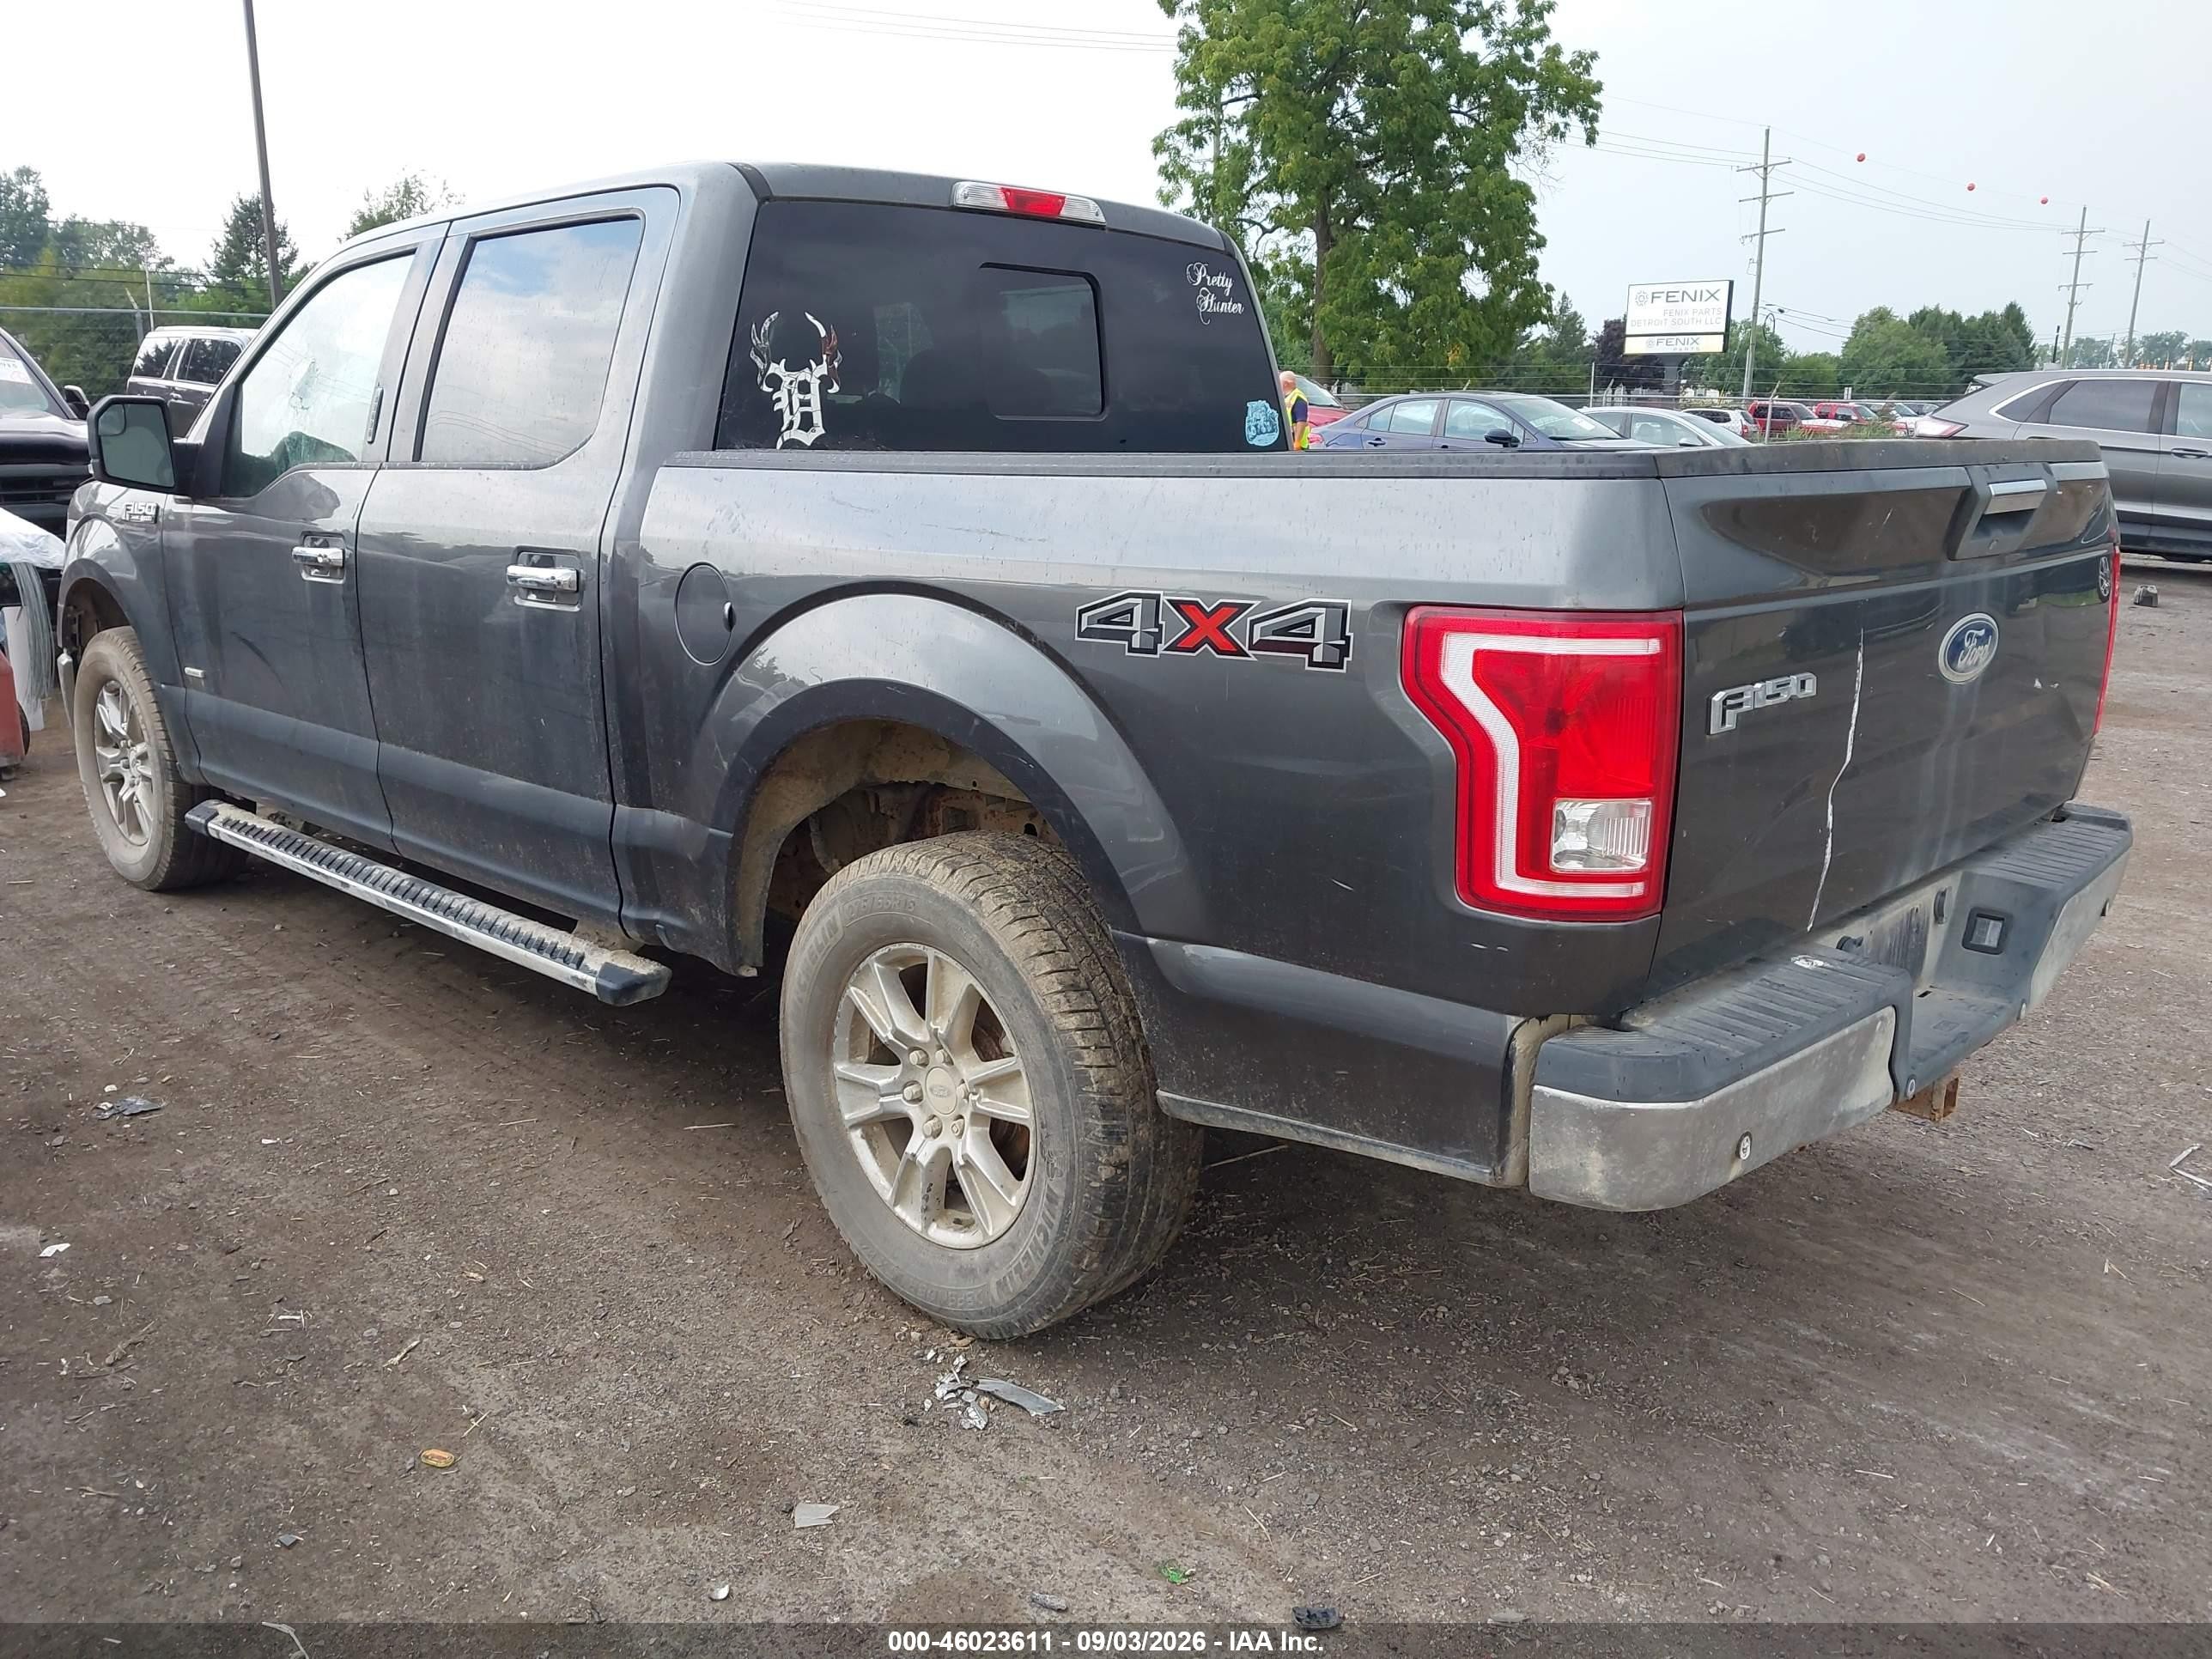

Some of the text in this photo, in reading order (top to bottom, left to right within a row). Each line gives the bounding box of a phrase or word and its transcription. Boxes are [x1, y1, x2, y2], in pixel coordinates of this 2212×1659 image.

[1186, 262, 1233, 296] Pretty
[1650, 289, 1721, 304] FENIX
[1195, 287, 1244, 325] Hunter
[1692, 307, 1723, 316] PARTS
[1631, 319, 1668, 327] DETROIT
[1671, 318, 1702, 326] SOUTH
[1656, 337, 1700, 346] FENIX
[995, 1183, 1061, 1301] MICHELIN
